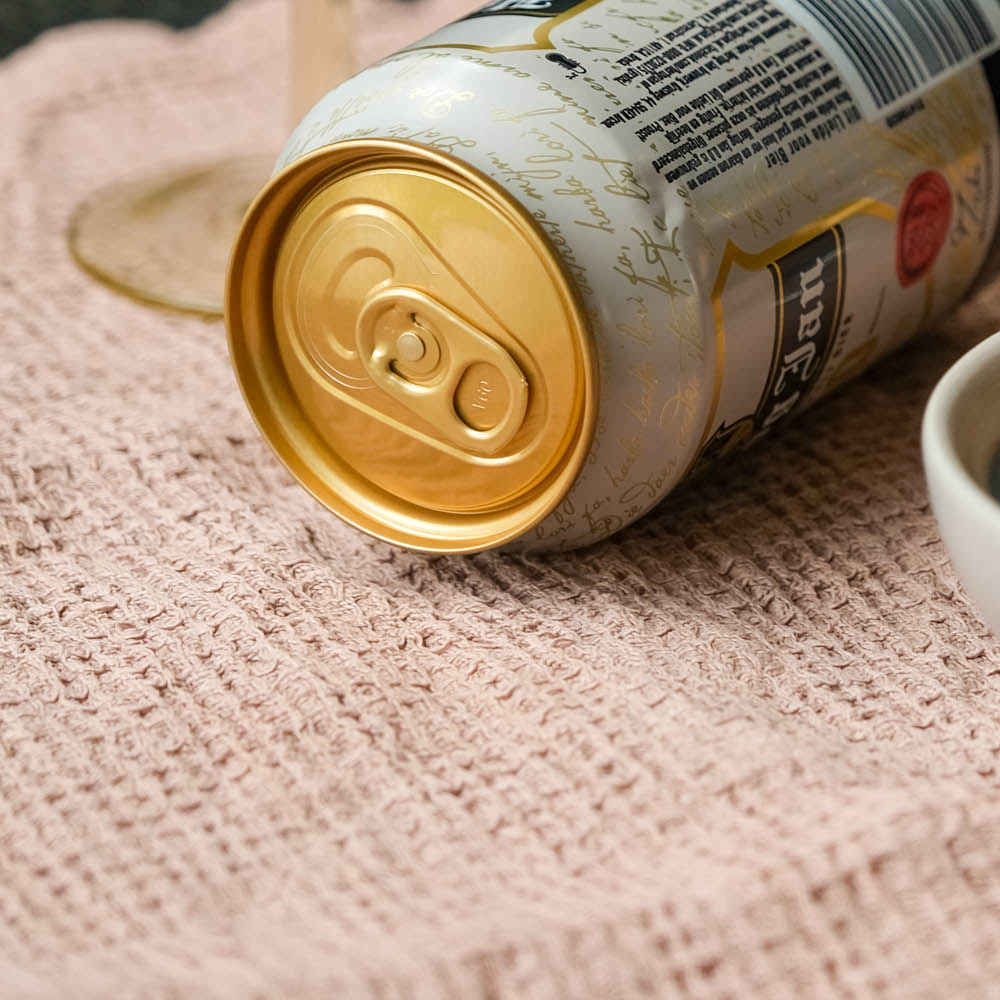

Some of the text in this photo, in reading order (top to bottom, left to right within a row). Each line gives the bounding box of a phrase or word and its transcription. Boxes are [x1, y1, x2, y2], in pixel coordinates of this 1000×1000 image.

[635, 121, 664, 142] Proost!
[811, 114, 845, 140] Liefde
[788, 134, 811, 155] voor
[765, 147, 789, 168] Bier
[774, 256, 825, 397] Jan
